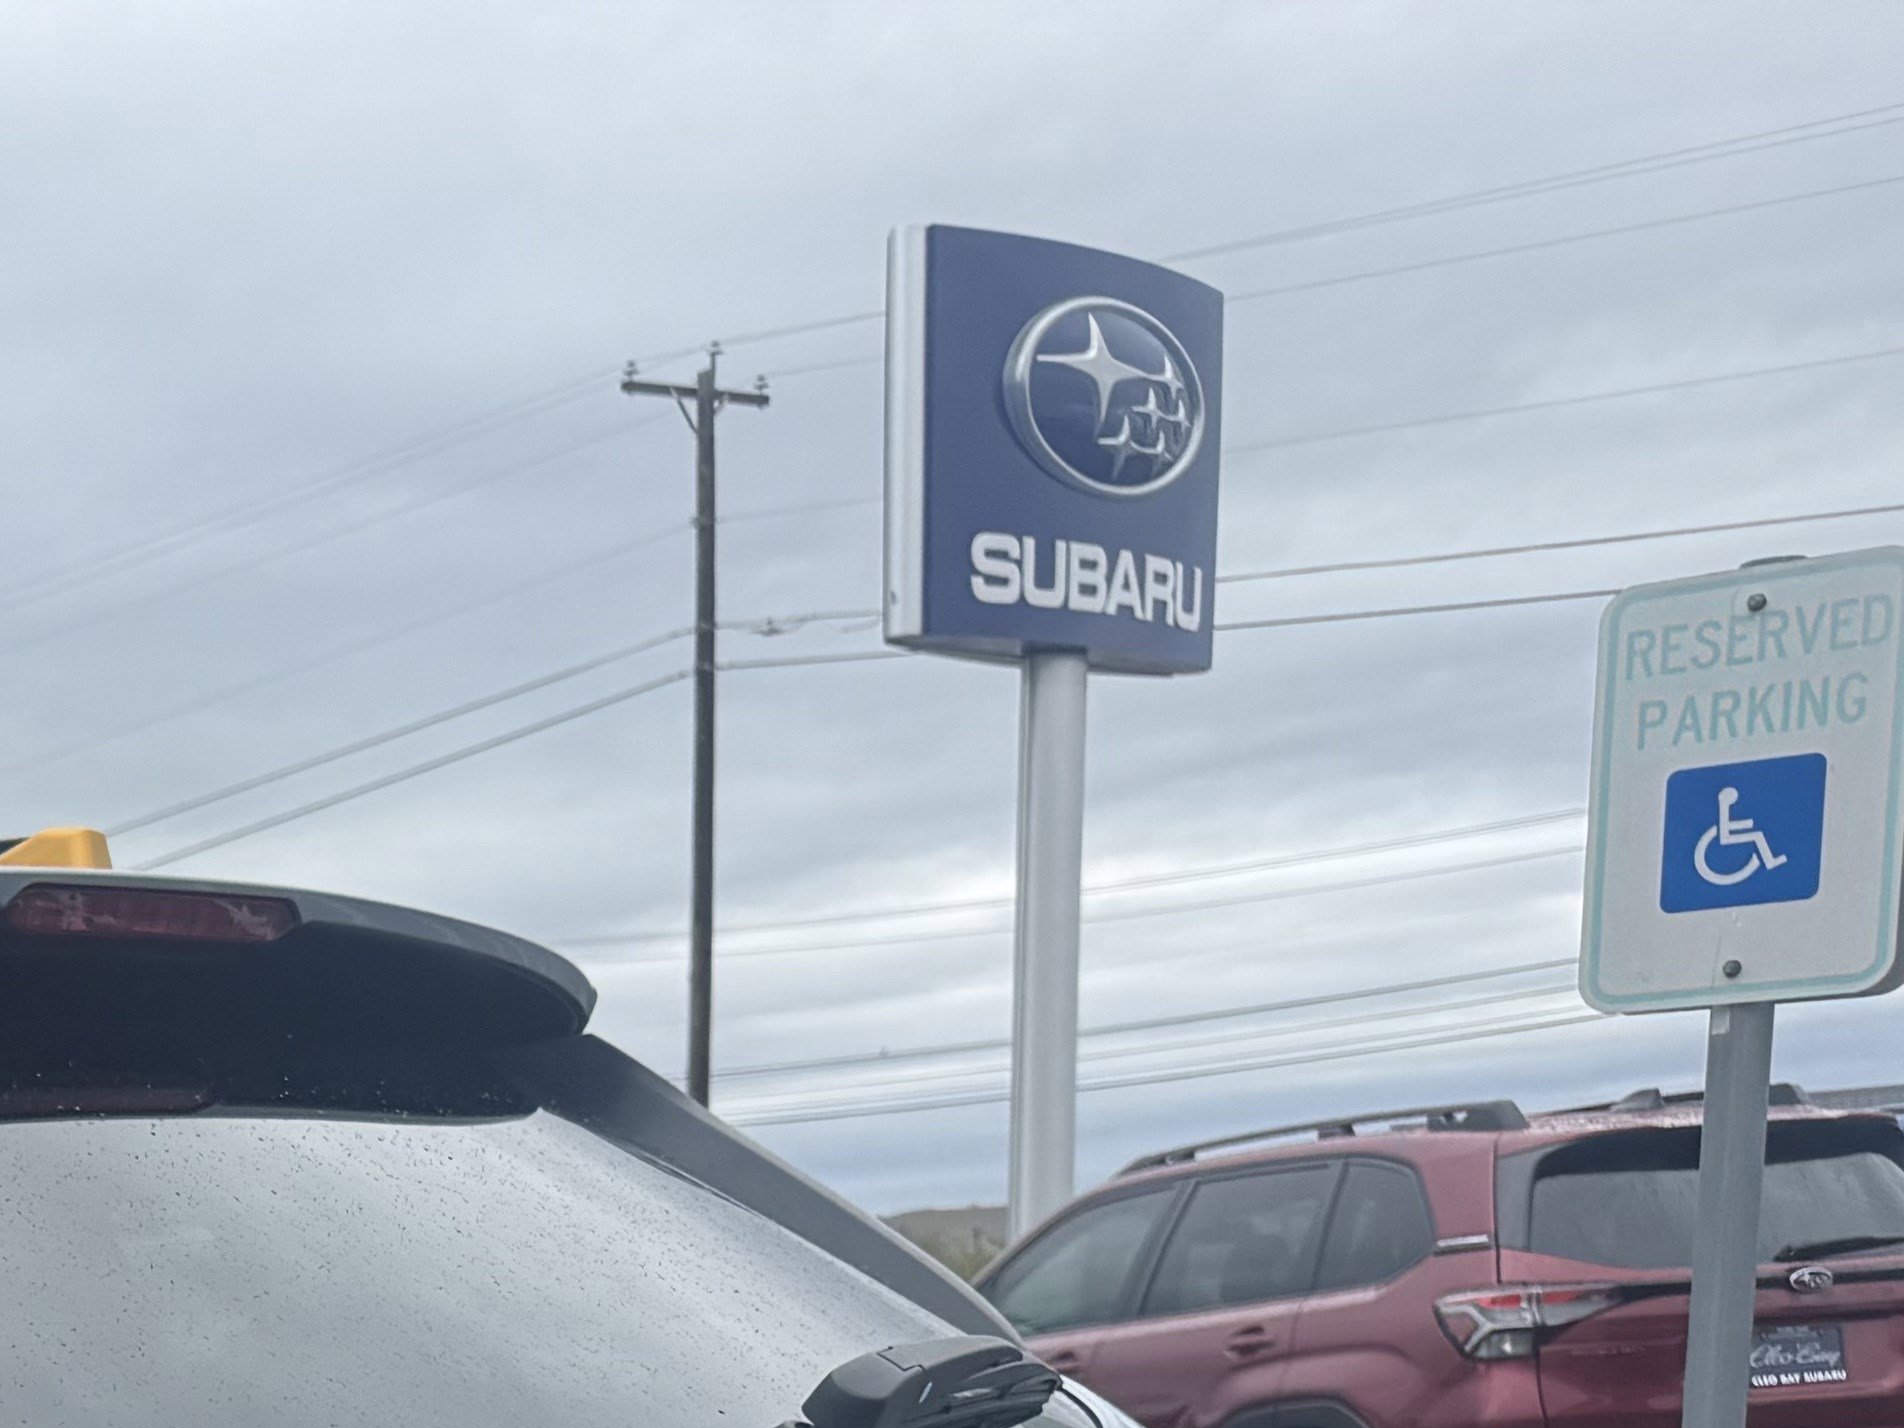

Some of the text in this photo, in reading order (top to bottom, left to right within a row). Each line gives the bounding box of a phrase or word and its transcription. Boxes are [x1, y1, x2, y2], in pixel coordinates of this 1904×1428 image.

[970, 531, 1203, 632] SUBARU
[1624, 593, 1891, 681] RESERVED
[1637, 671, 1868, 751] PARKING
